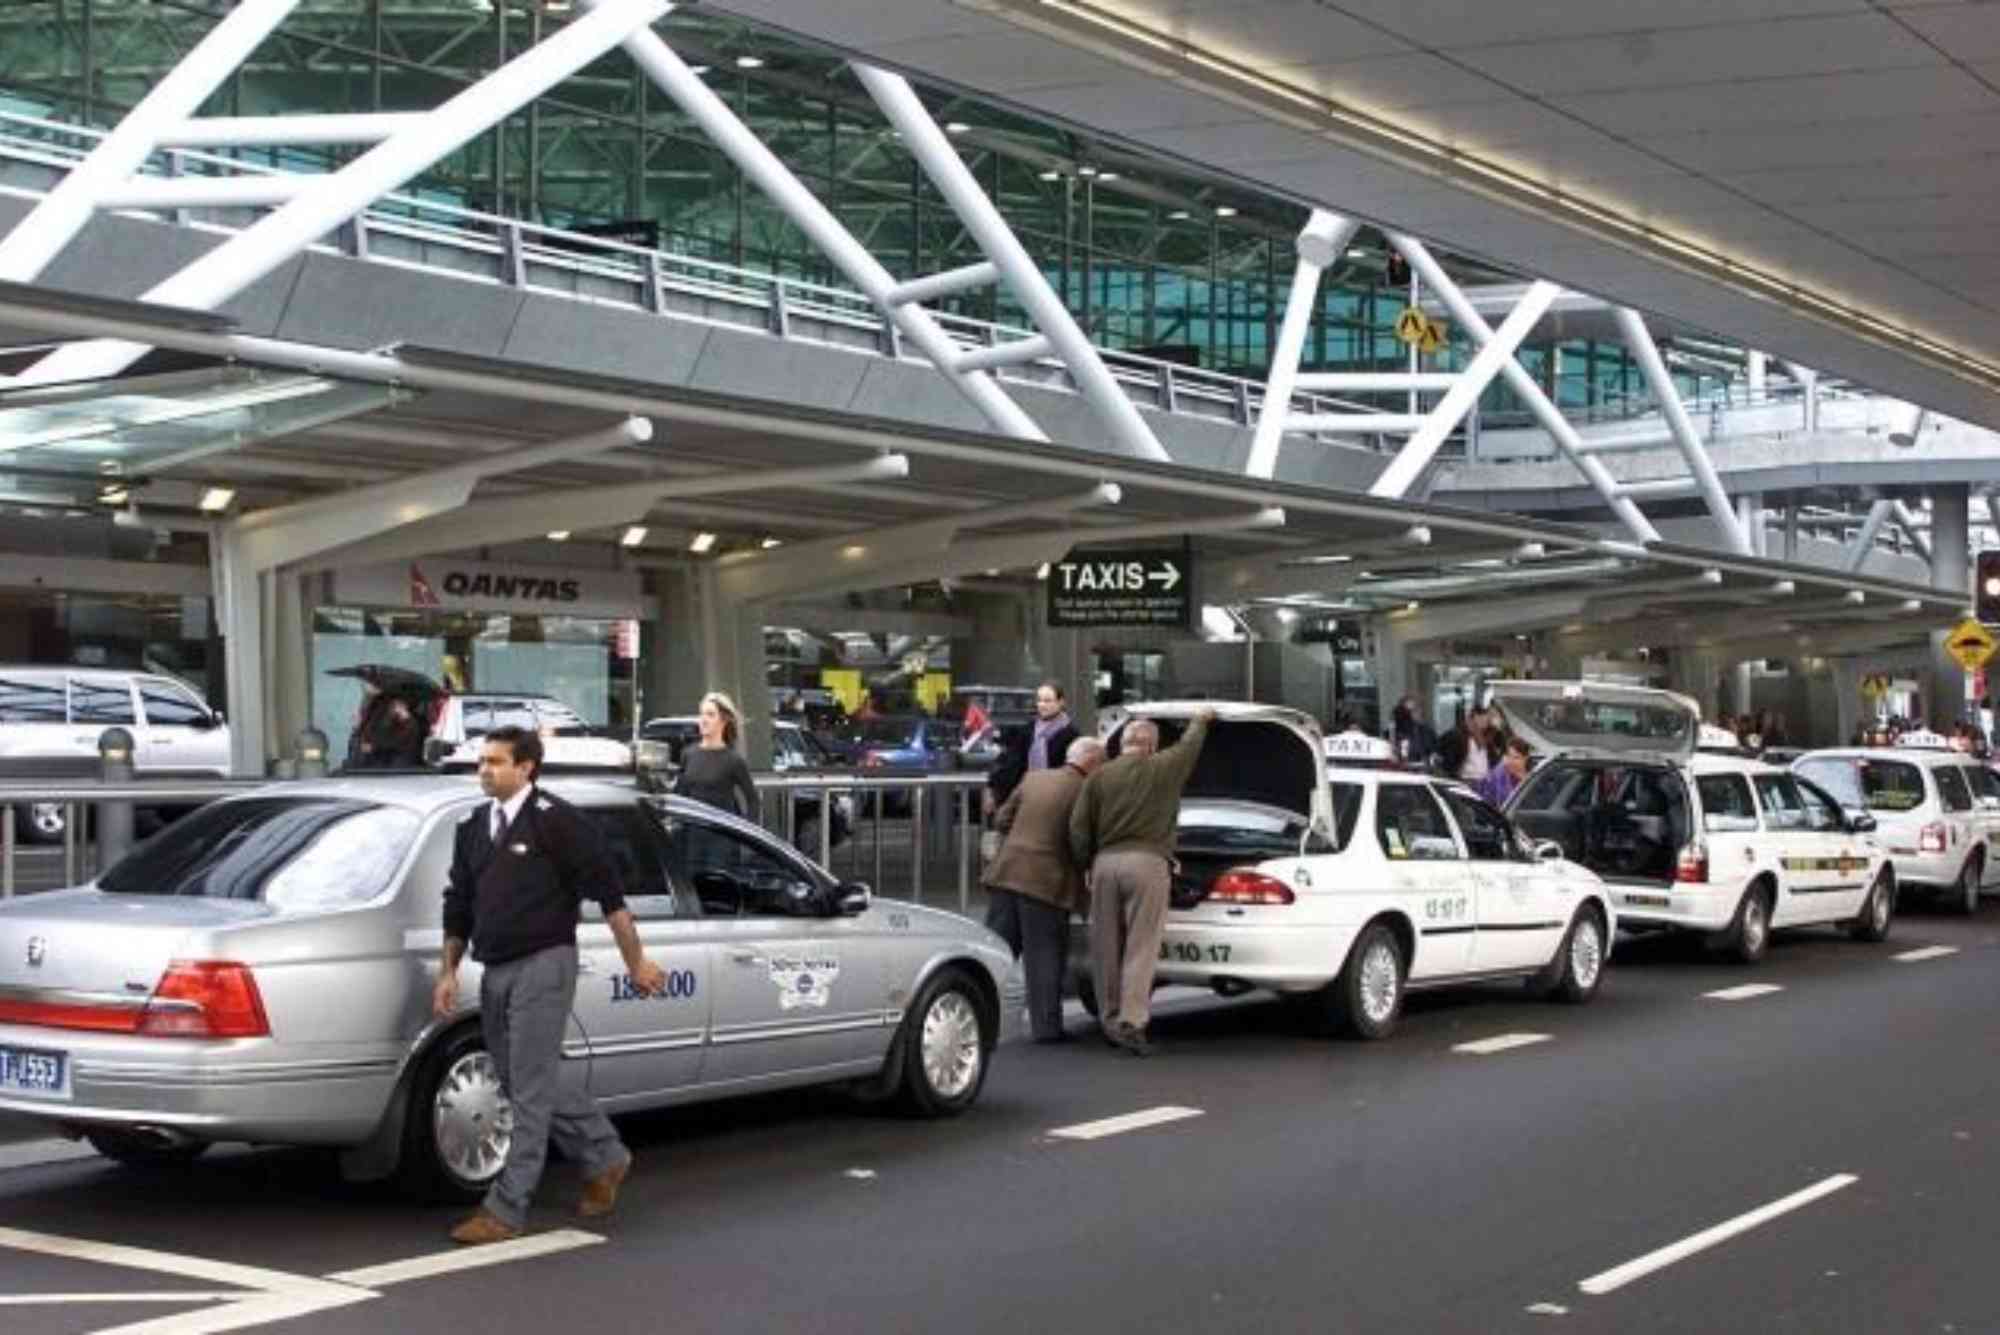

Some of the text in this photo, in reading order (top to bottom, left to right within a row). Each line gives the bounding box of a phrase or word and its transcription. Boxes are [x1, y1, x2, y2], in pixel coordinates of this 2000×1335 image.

[442, 571, 580, 602] QANTAS
[1059, 562, 1144, 590] TAXIS
[1174, 941, 1201, 962] 10
[1207, 943, 1232, 962] 17
